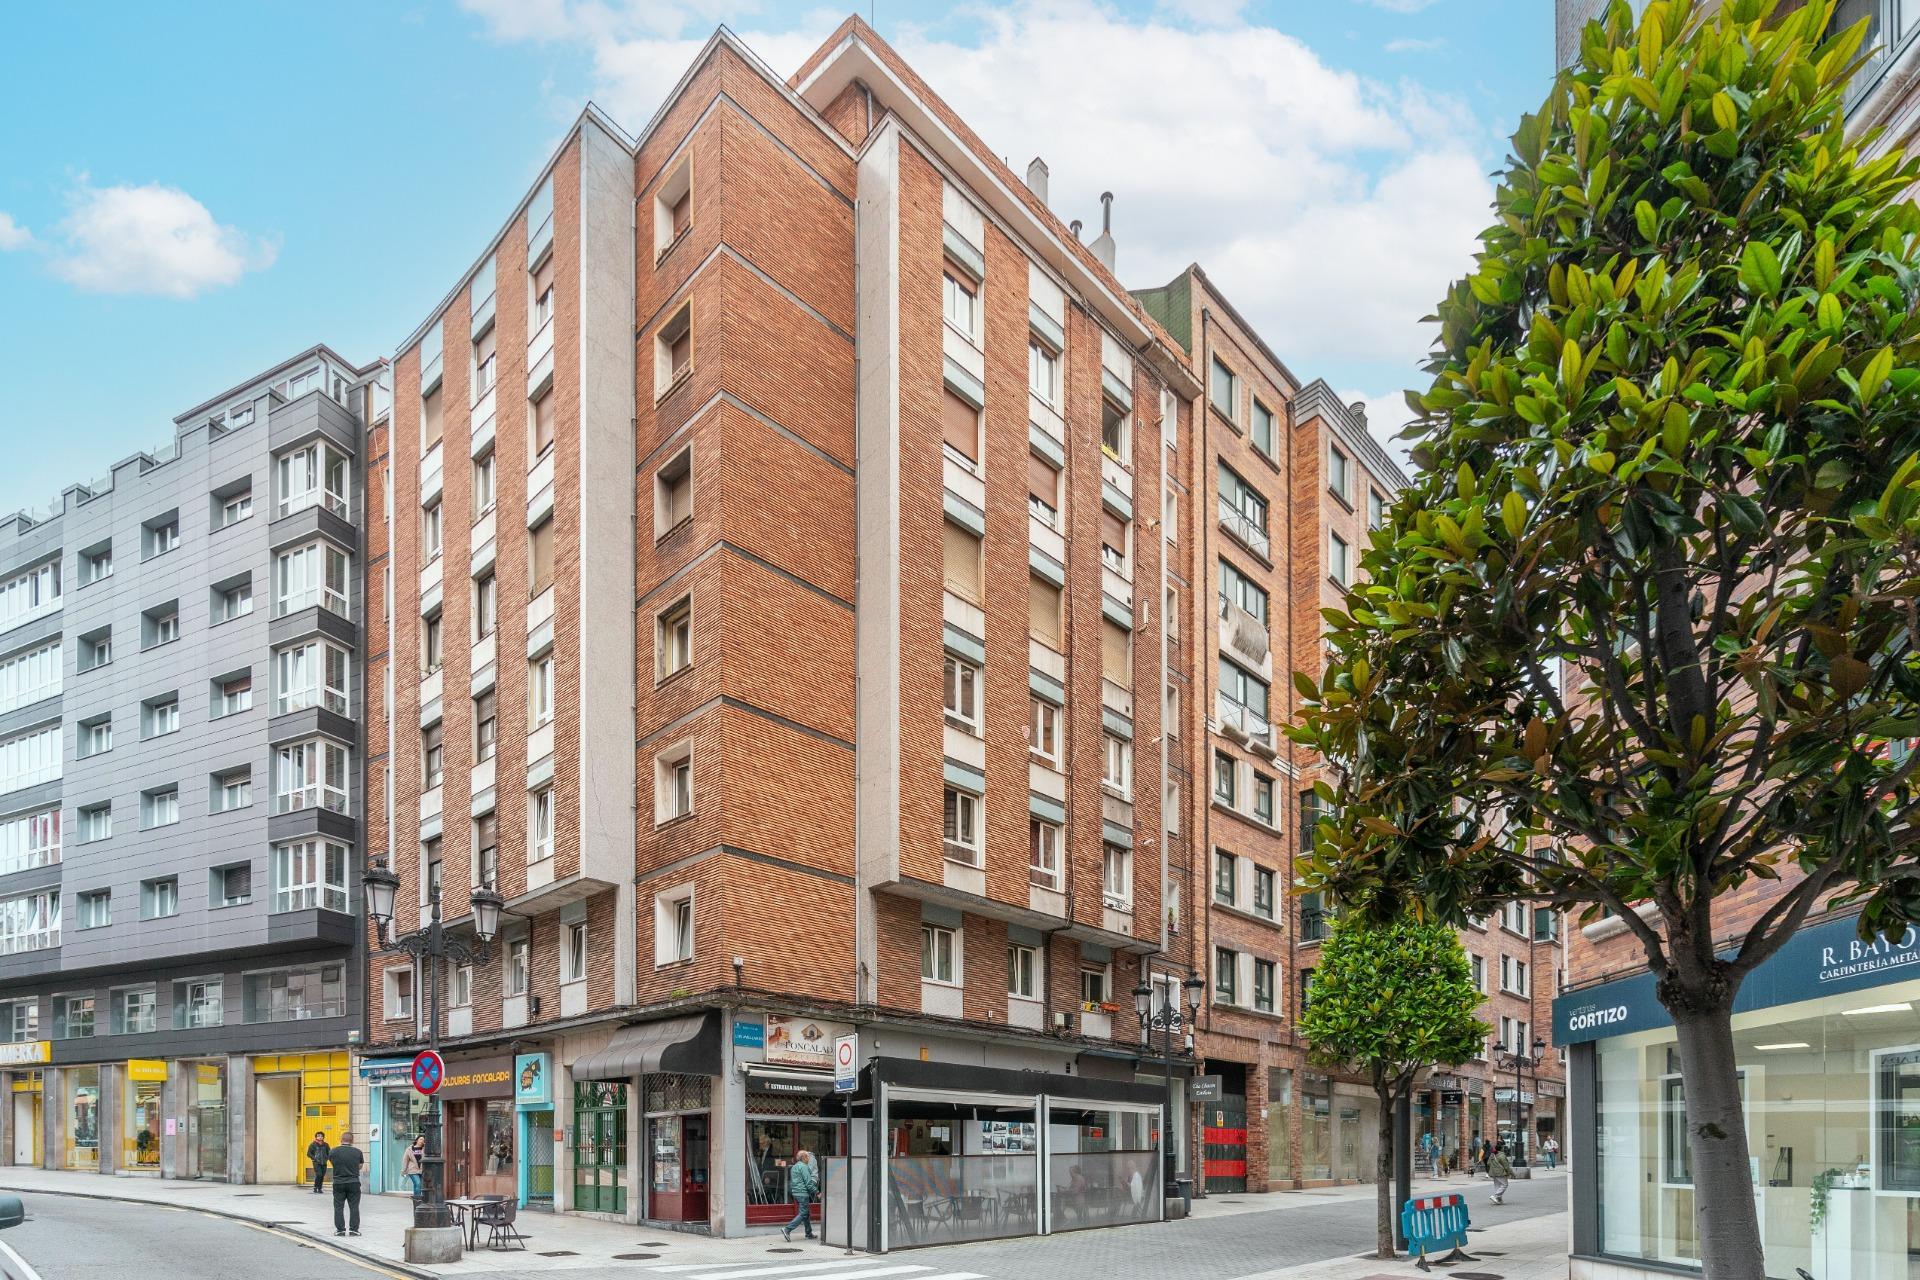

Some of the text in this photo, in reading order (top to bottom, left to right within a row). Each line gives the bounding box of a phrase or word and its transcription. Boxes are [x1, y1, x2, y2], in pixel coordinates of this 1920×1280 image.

[1818, 950, 1919, 980] CARPINTERÍA META
[1822, 946, 1844, 967] R.
[1569, 1005, 1628, 1031] CORTIZO
[784, 1040, 835, 1055] FONCALAD
[441, 1076, 471, 1088] OLDURAS
[472, 1070, 510, 1084] FONCALADA
